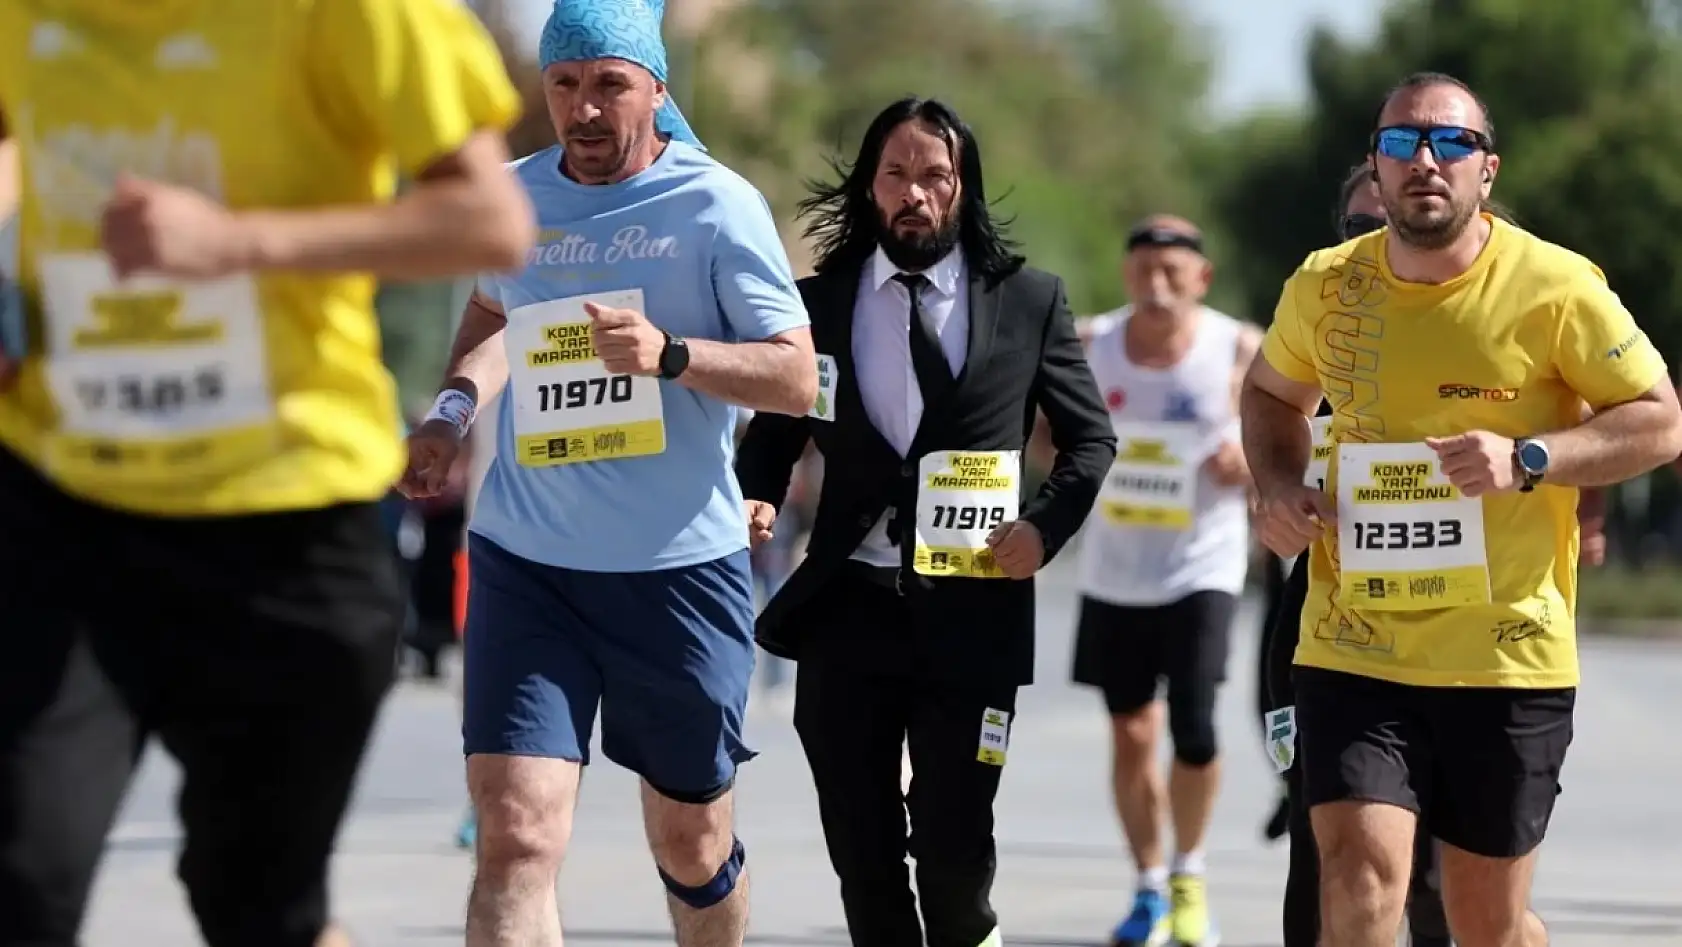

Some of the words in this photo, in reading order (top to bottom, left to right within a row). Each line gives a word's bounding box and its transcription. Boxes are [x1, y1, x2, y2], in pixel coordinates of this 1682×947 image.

[604, 224, 681, 264] Run
[547, 324, 590, 340] KONY
[557, 337, 589, 348] YAR
[532, 347, 599, 364] MARAT
[538, 375, 632, 411] 11970
[952, 457, 997, 467] KONYA
[960, 468, 991, 477] YARI
[1373, 463, 1429, 477] KONYA
[933, 476, 1009, 488] MARATONU
[1381, 478, 1418, 488] YARI
[1358, 487, 1451, 501] MARATONU
[932, 505, 1004, 529] 11919
[1354, 520, 1461, 549] 12333
